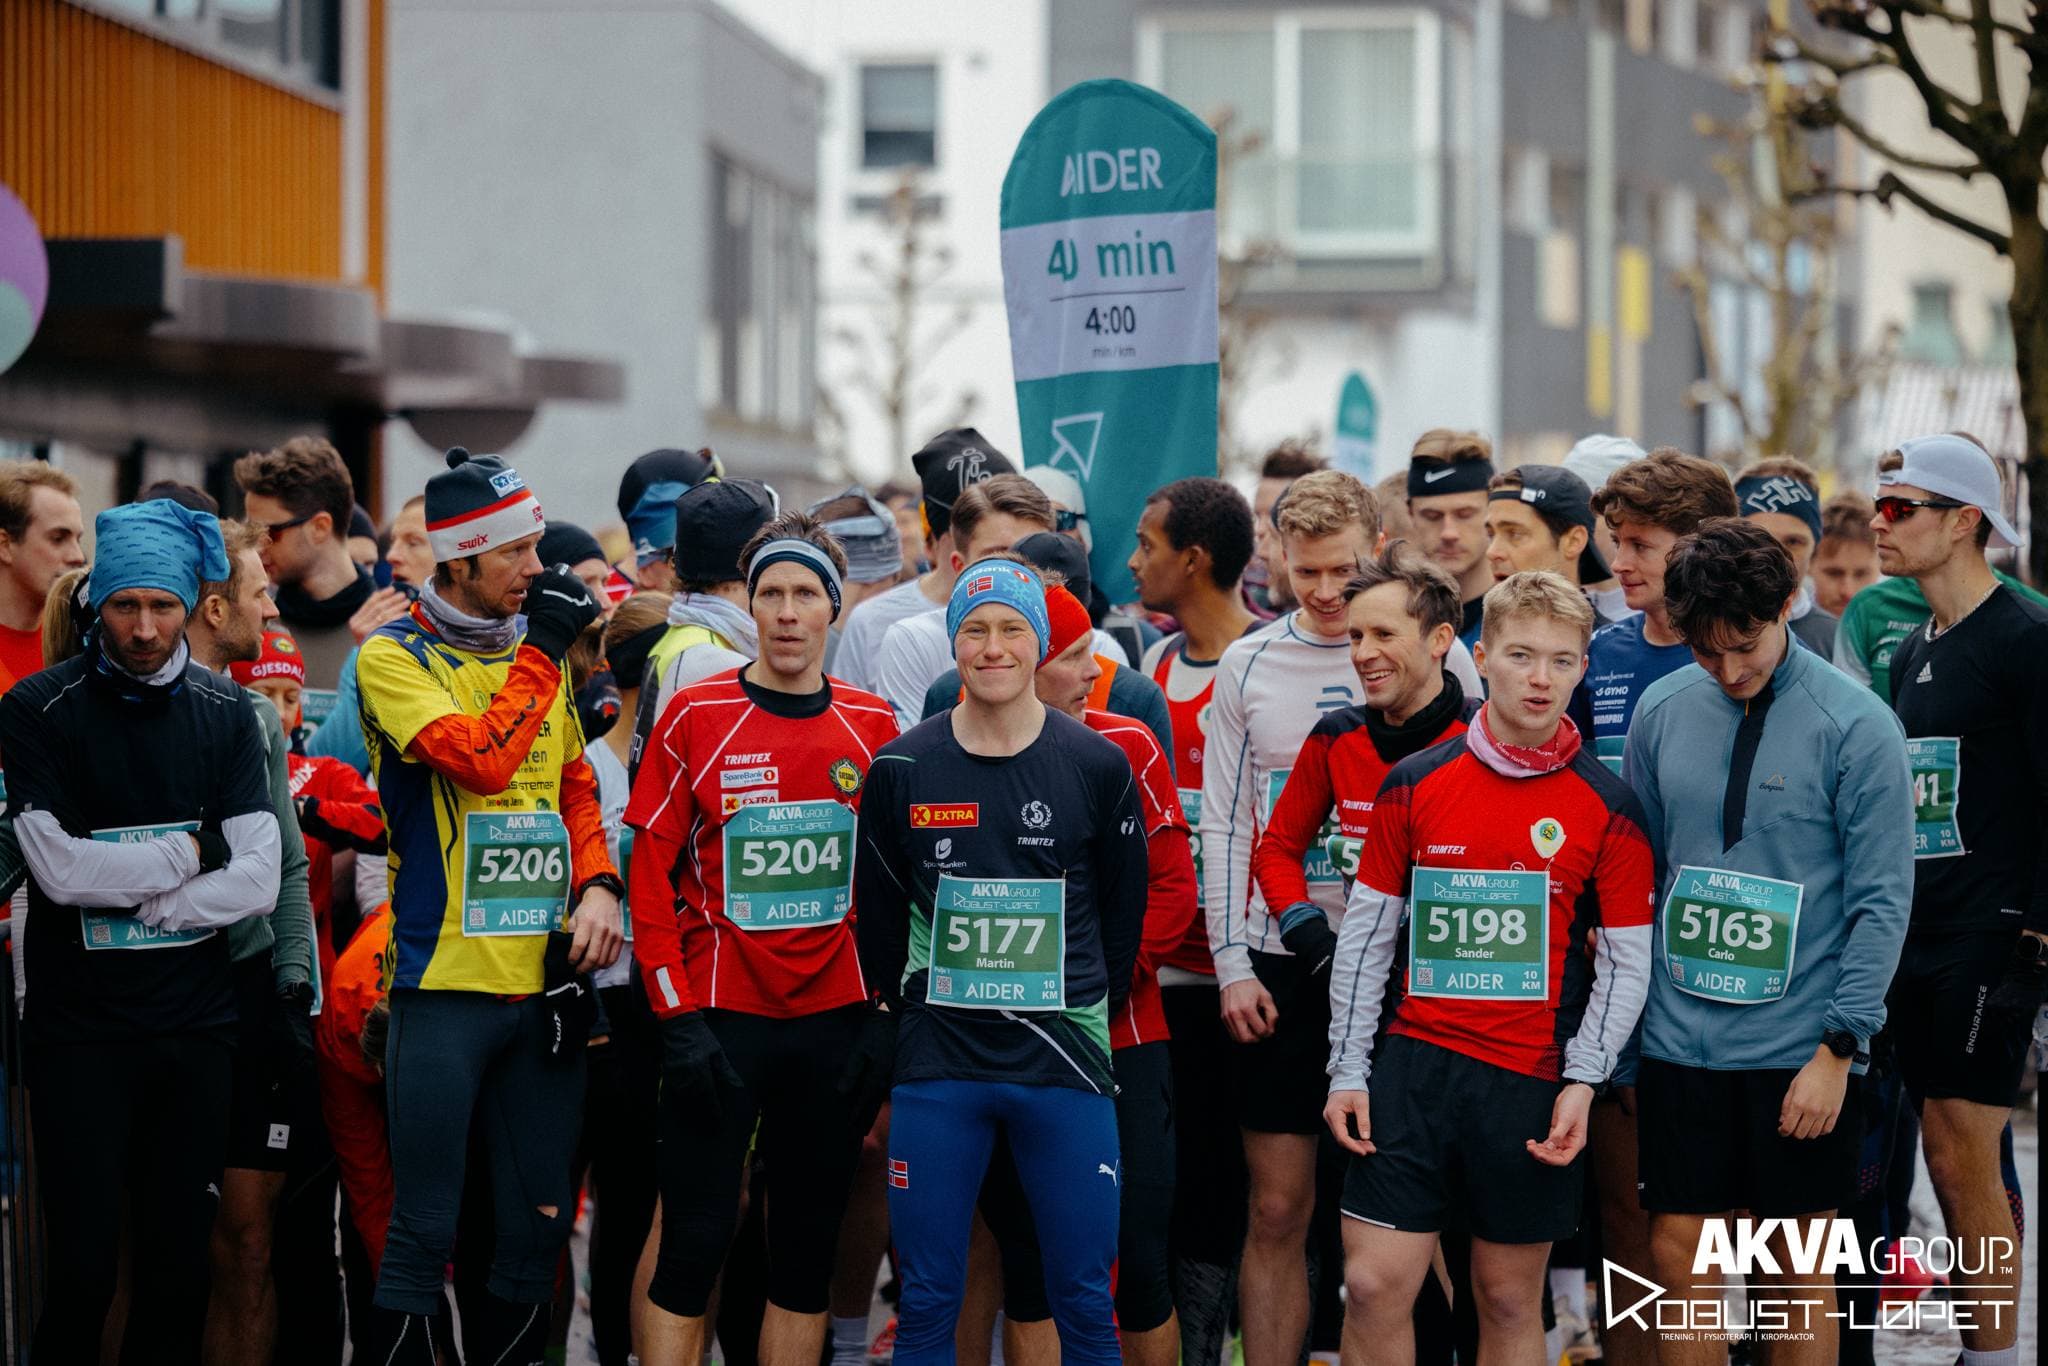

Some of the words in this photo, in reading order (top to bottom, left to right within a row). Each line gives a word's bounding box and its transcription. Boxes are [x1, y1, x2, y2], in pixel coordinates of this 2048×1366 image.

[1060, 148, 1164, 197] AIDER
[1096, 230, 1176, 278] min
[1085, 305, 1136, 335] 4:00
[724, 752, 772, 766] TRIMTEX
[723, 770, 762, 782] SpareBank
[768, 807, 802, 821] AKVA
[803, 809, 832, 819] GROUP
[934, 809, 974, 821] EXTRA
[506, 816, 536, 829] AKVA
[1017, 836, 1055, 848] TRIMTEX
[742, 837, 841, 876] 5204
[1427, 845, 1466, 855] TRIMTEX
[477, 847, 563, 883] 5206
[1451, 874, 1487, 887] AKVA
[1487, 879, 1519, 889] GROUP
[1707, 873, 1741, 890] AKVA
[1740, 882, 1773, 897] GROUP
[971, 883, 1009, 897] AKVA
[1010, 887, 1040, 897] GROUP
[835, 894, 845, 902] 10
[766, 901, 822, 920] AIDER
[834, 902, 847, 913] KM
[499, 909, 548, 926] AIDER
[1427, 906, 1527, 945] 5198
[1679, 903, 1773, 950] 5163
[947, 915, 1046, 955] 5177
[1455, 948, 1495, 959] Sander
[1708, 947, 1735, 961] Carlo
[976, 958, 1015, 969] Martin
[1446, 972, 1504, 990] AIDER
[1523, 970, 1537, 980] 10
[1767, 976, 1780, 986] 10
[1043, 980, 1055, 989] 10
[1522, 980, 1541, 990] KM
[1694, 971, 1746, 994] AIDER
[1763, 985, 1781, 994] KM
[965, 982, 1025, 1000] AIDER
[1042, 990, 1058, 1000] KM
[1966, 985, 1988, 1054] ENDURANCE
